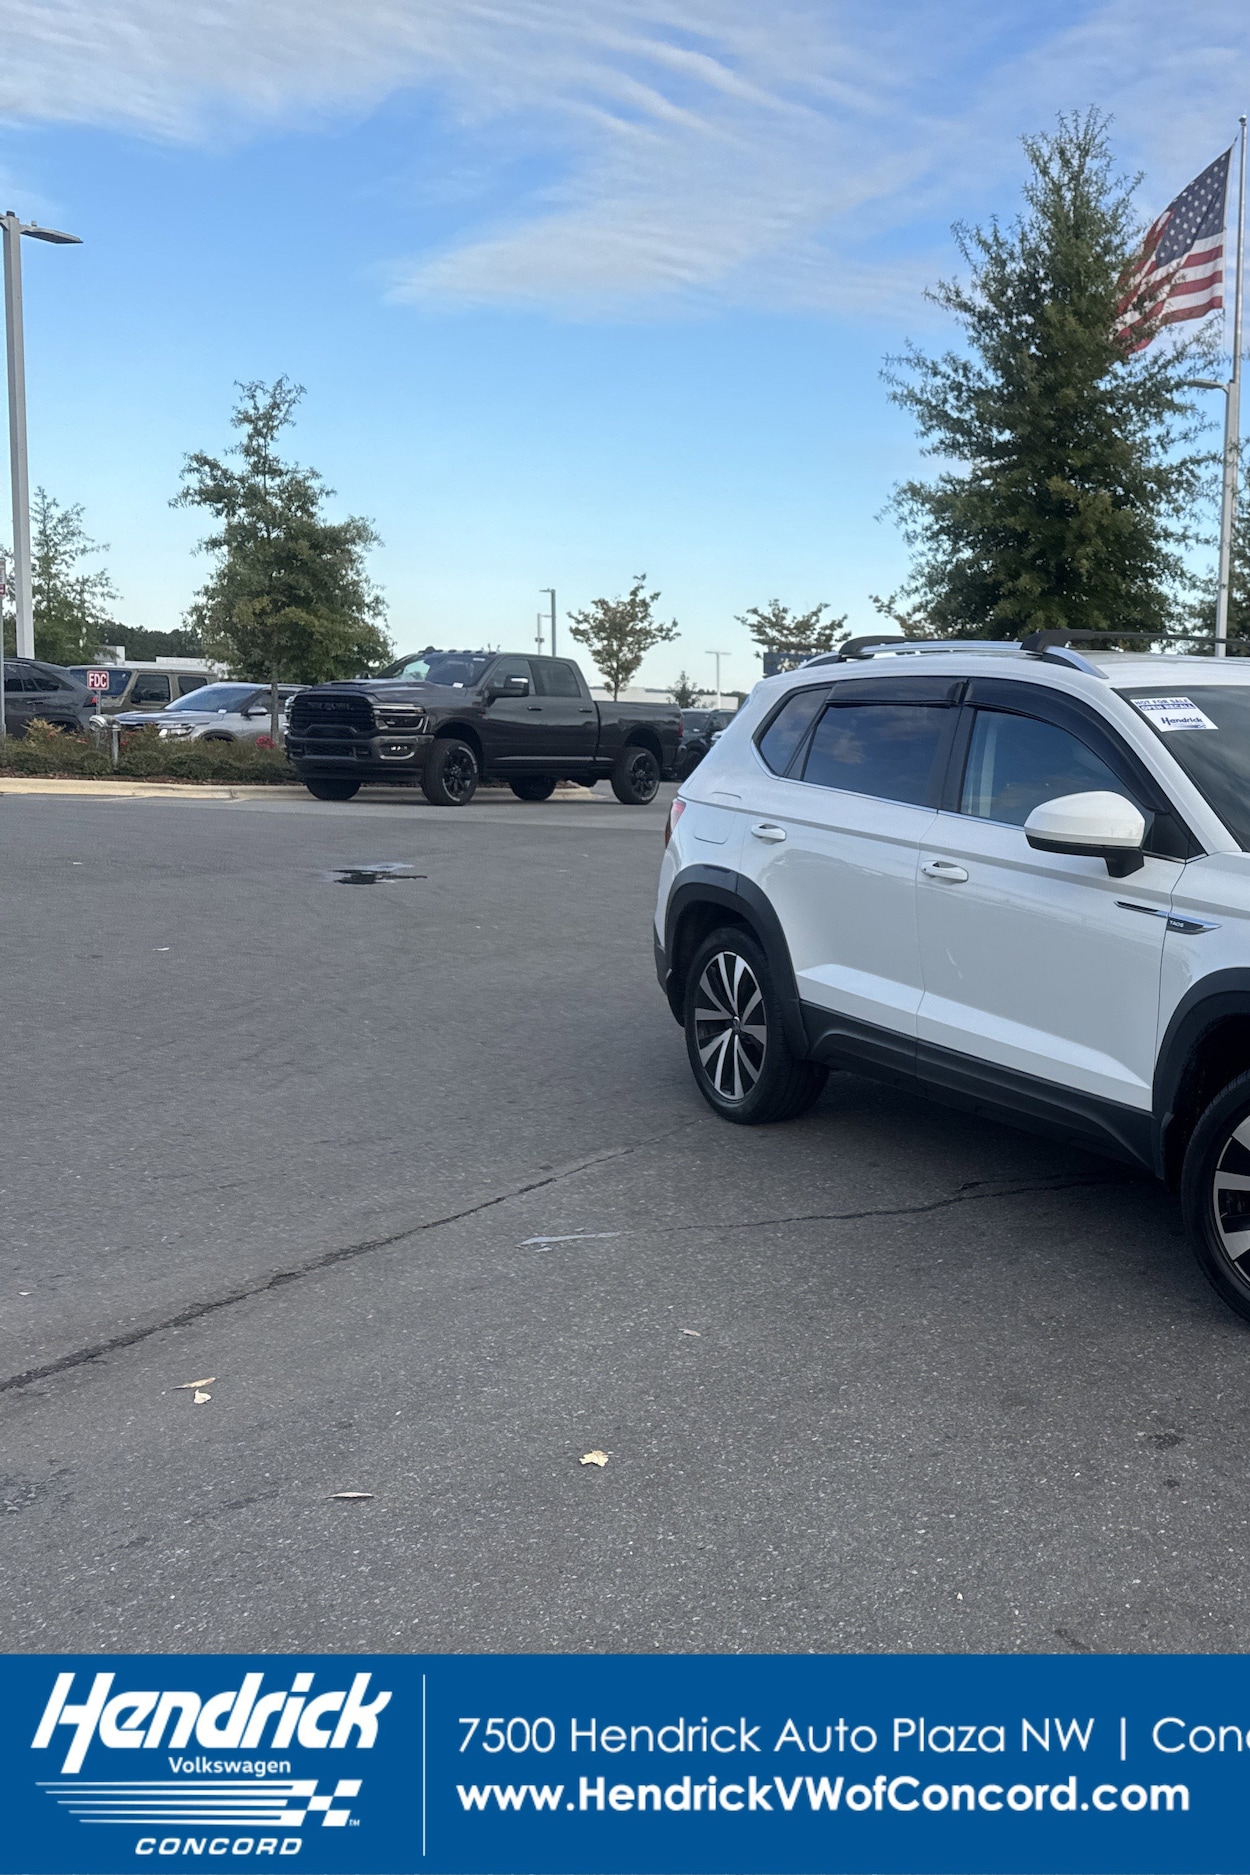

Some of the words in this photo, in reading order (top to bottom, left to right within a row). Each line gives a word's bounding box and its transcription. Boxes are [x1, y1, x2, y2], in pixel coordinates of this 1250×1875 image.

[89, 673, 107, 687] FDC
[1161, 717, 1203, 726] Hendrick
[1169, 920, 1184, 928] TAOS
